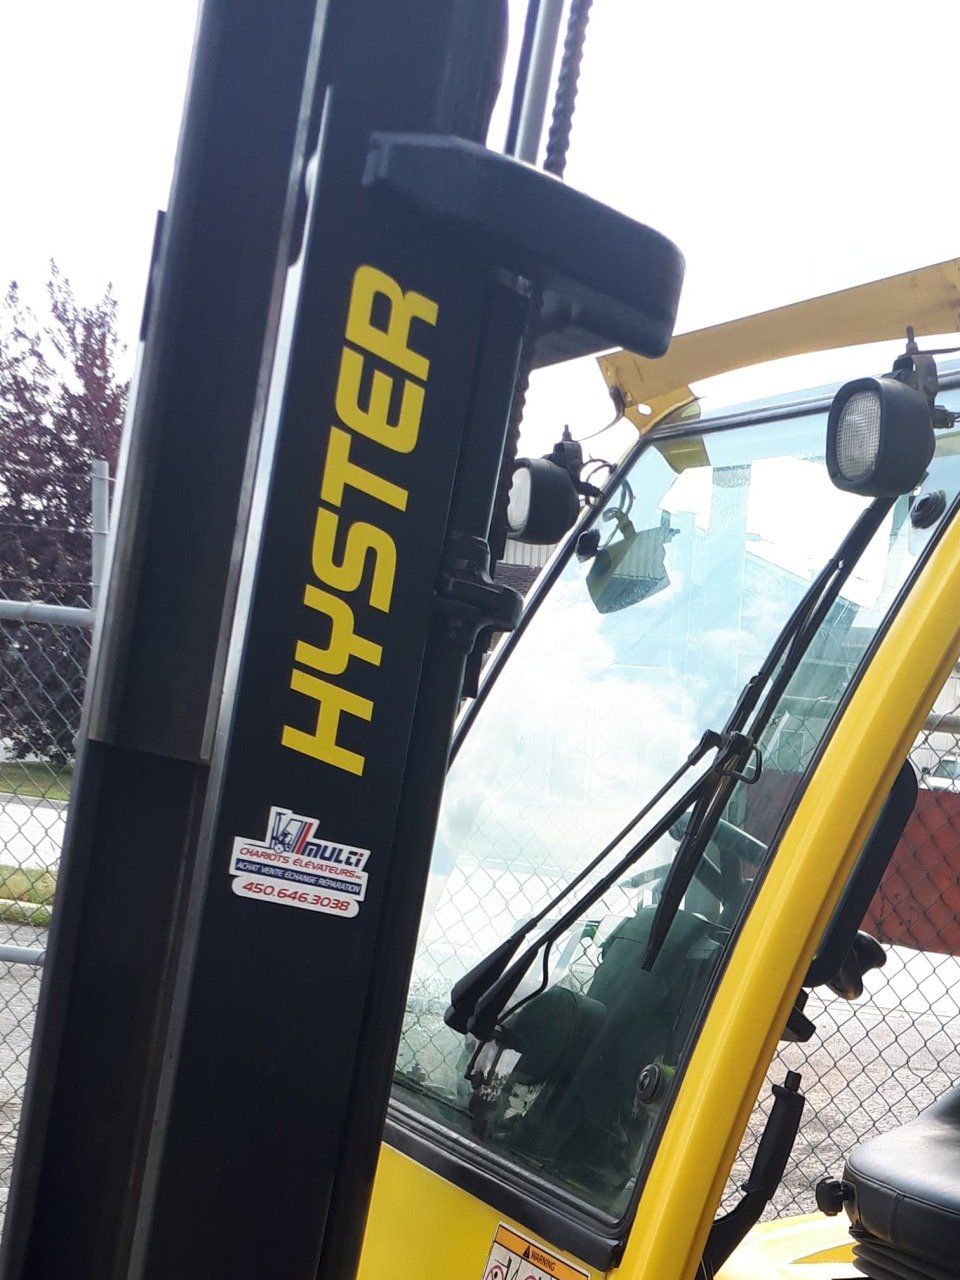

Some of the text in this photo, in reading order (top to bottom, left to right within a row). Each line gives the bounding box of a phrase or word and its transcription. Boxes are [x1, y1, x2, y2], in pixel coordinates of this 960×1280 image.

[281, 264, 439, 777] HYSTER
[236, 861, 260, 873] ACHAT
[260, 866, 284, 877] VENTE
[240, 846, 289, 864] CHARIOTS
[293, 857, 356, 878] ÉLÉVATEURS
[243, 881, 350, 911] 450.646.3038
[531, 1250, 556, 1272] WARNING
